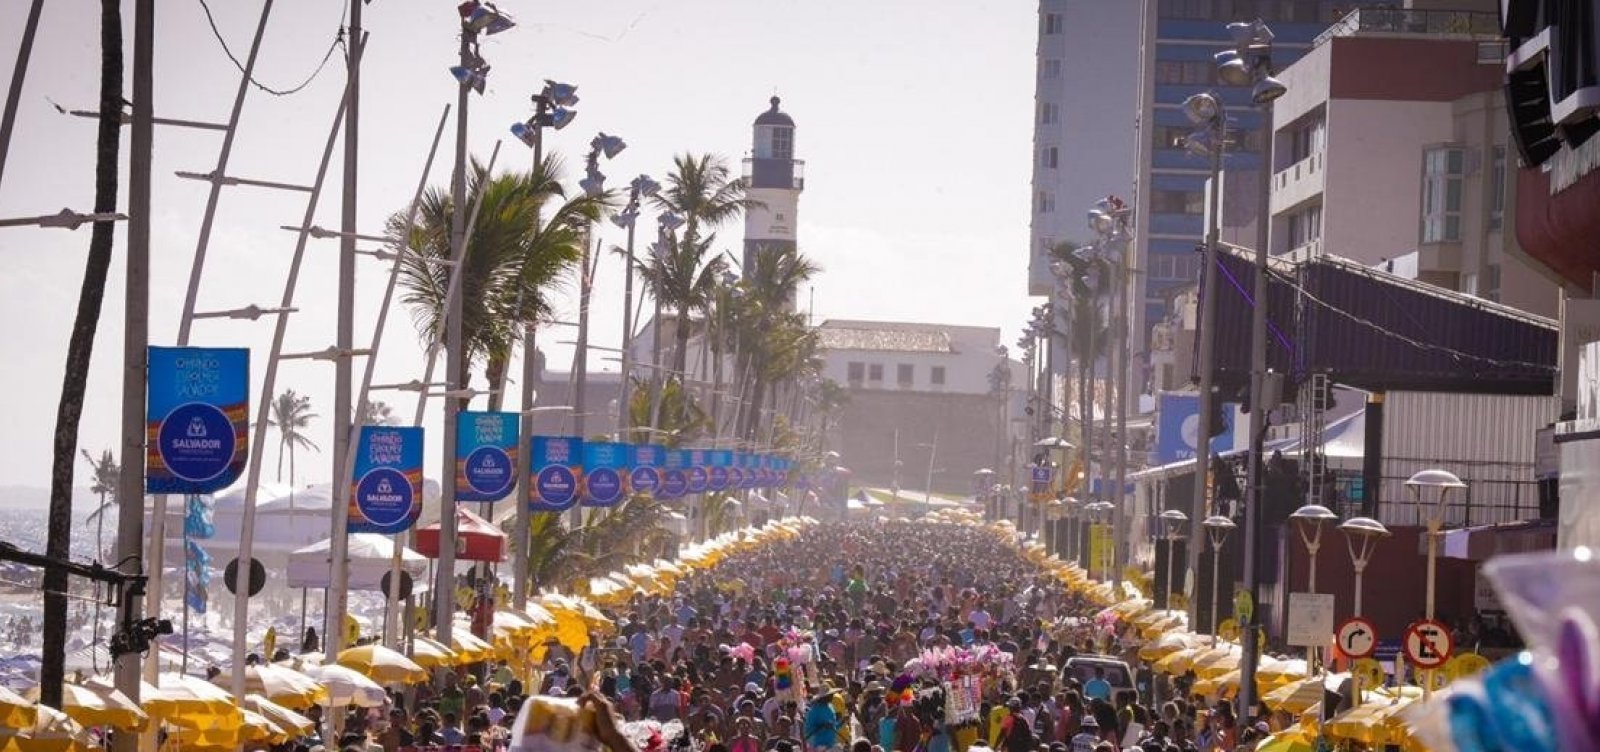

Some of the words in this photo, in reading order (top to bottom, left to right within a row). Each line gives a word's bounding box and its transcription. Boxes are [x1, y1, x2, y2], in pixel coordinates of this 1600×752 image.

[172, 438, 221, 449] SALVADOR
[366, 493, 403, 502] SALVADOR
[1419, 629, 1438, 658] E
